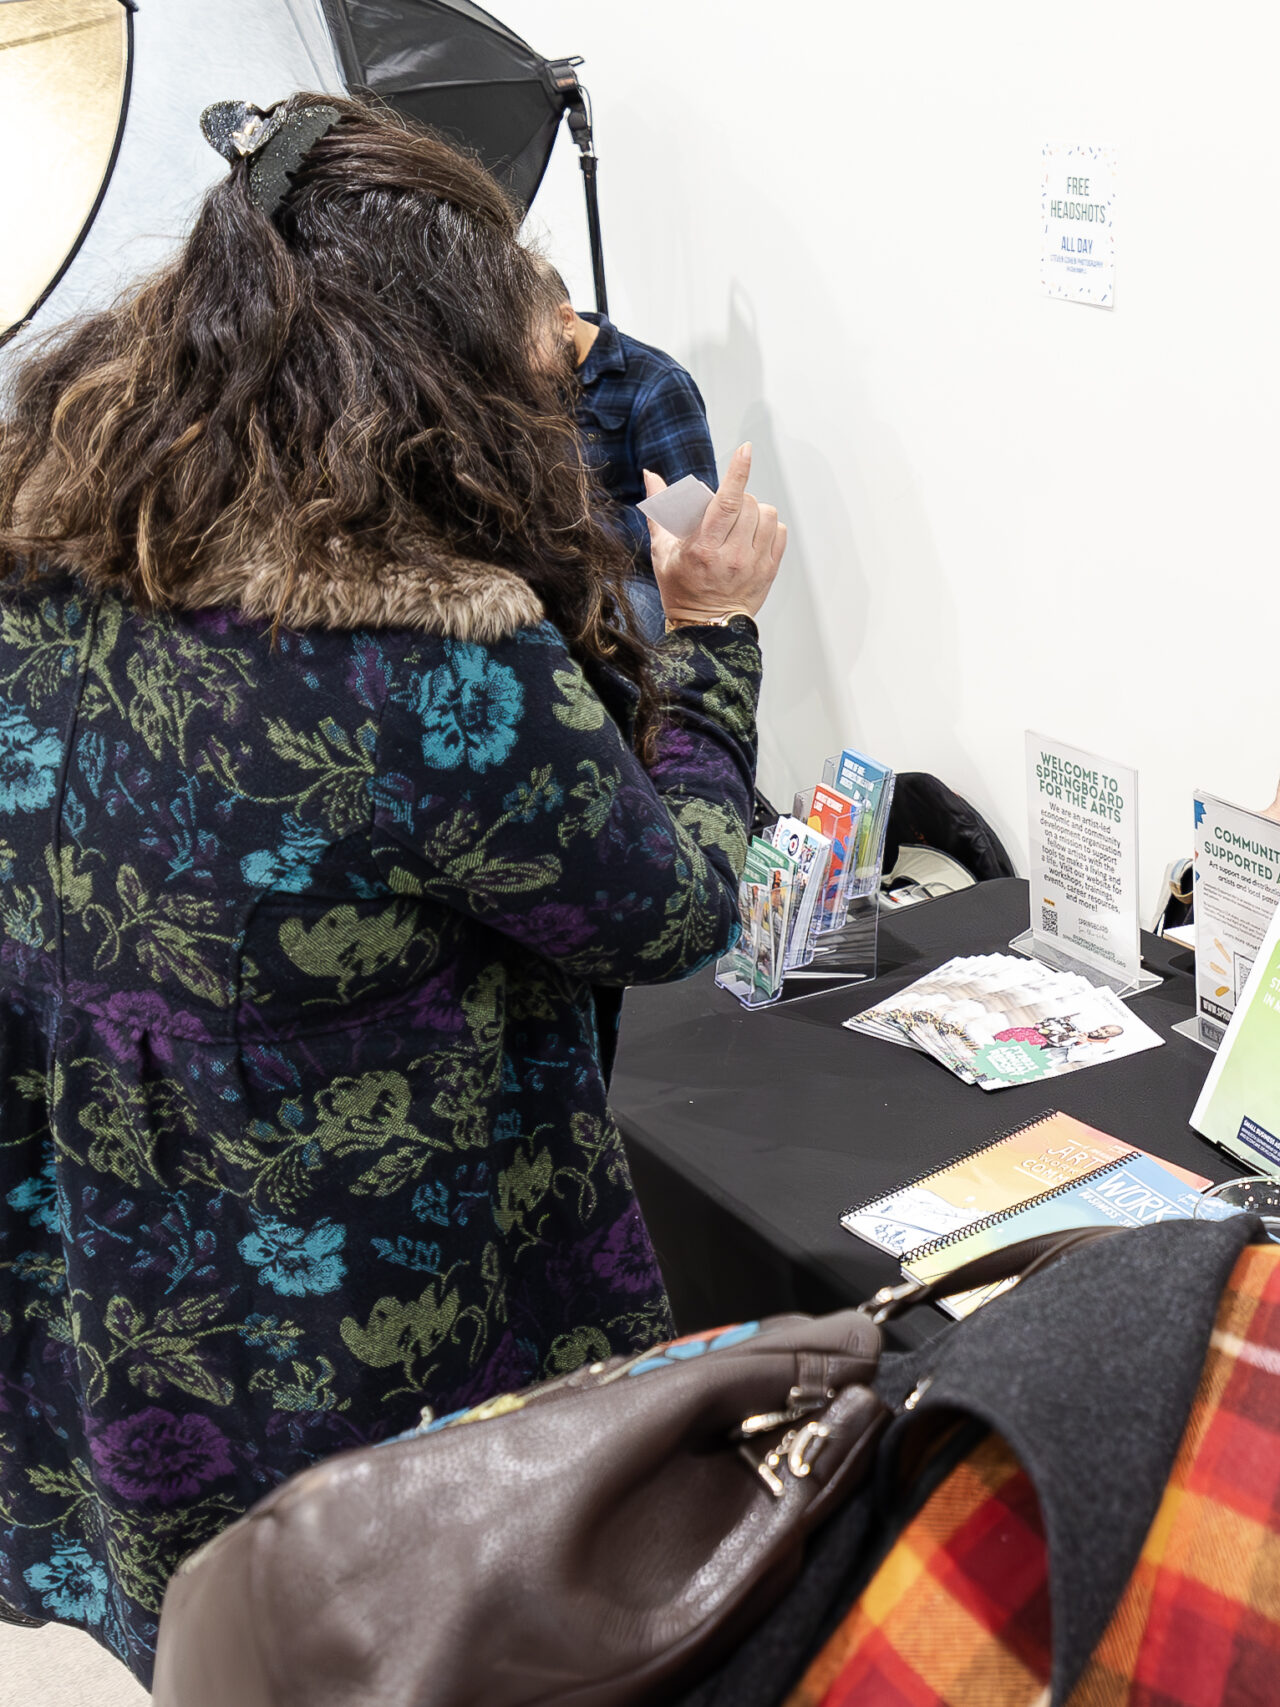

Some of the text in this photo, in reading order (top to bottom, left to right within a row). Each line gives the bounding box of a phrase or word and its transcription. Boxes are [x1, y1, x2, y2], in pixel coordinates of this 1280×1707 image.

[1067, 176, 1090, 196] FREE
[1050, 200, 1106, 224] HEADSHOTS
[1061, 235, 1093, 255] ALL DAY
[1036, 764, 1124, 810] SPRINGBOARD
[1040, 751, 1118, 792] WELCOME TO
[1040, 779, 1121, 823] FOR THE ARTS
[1049, 802, 1111, 835] We are an artist-led
[1040, 809, 1121, 848] economic and community
[1040, 817, 1122, 857] development organization
[1044, 829, 1053, 838] on
[1059, 835, 1082, 850] mission
[1083, 845, 1091, 853] to
[1092, 849, 1117, 865] support
[1047, 837, 1115, 873] fellow artists with the
[1204, 841, 1273, 880] SUPPORTED
[1042, 845, 1057, 858] tools
[1066, 857, 1084, 869] make
[1090, 865, 1107, 881] living
[1108, 875, 1121, 886] and
[1046, 855, 1058, 867] life.
[1059, 861, 1073, 874] Visit
[1074, 869, 1085, 878] our
[1086, 875, 1111, 890] website
[1112, 884, 1122, 895] for
[1209, 860, 1218, 870] Art
[1219, 866, 1240, 879] support
[1240, 875, 1252, 885] and
[1044, 874, 1121, 914] events, career resources,
[1049, 867, 1115, 902] workshops, trainings,
[1218, 876, 1279, 906] artists and local patro
[1065, 893, 1078, 903] and
[1078, 899, 1098, 912] more!
[1263, 991, 1275, 1008] IN
[1022, 1159, 1070, 1183] COMM
[1039, 1154, 1078, 1175] WORK
[1078, 1190, 1122, 1219] BUSINESS
[1095, 1172, 1182, 1224] WORK
